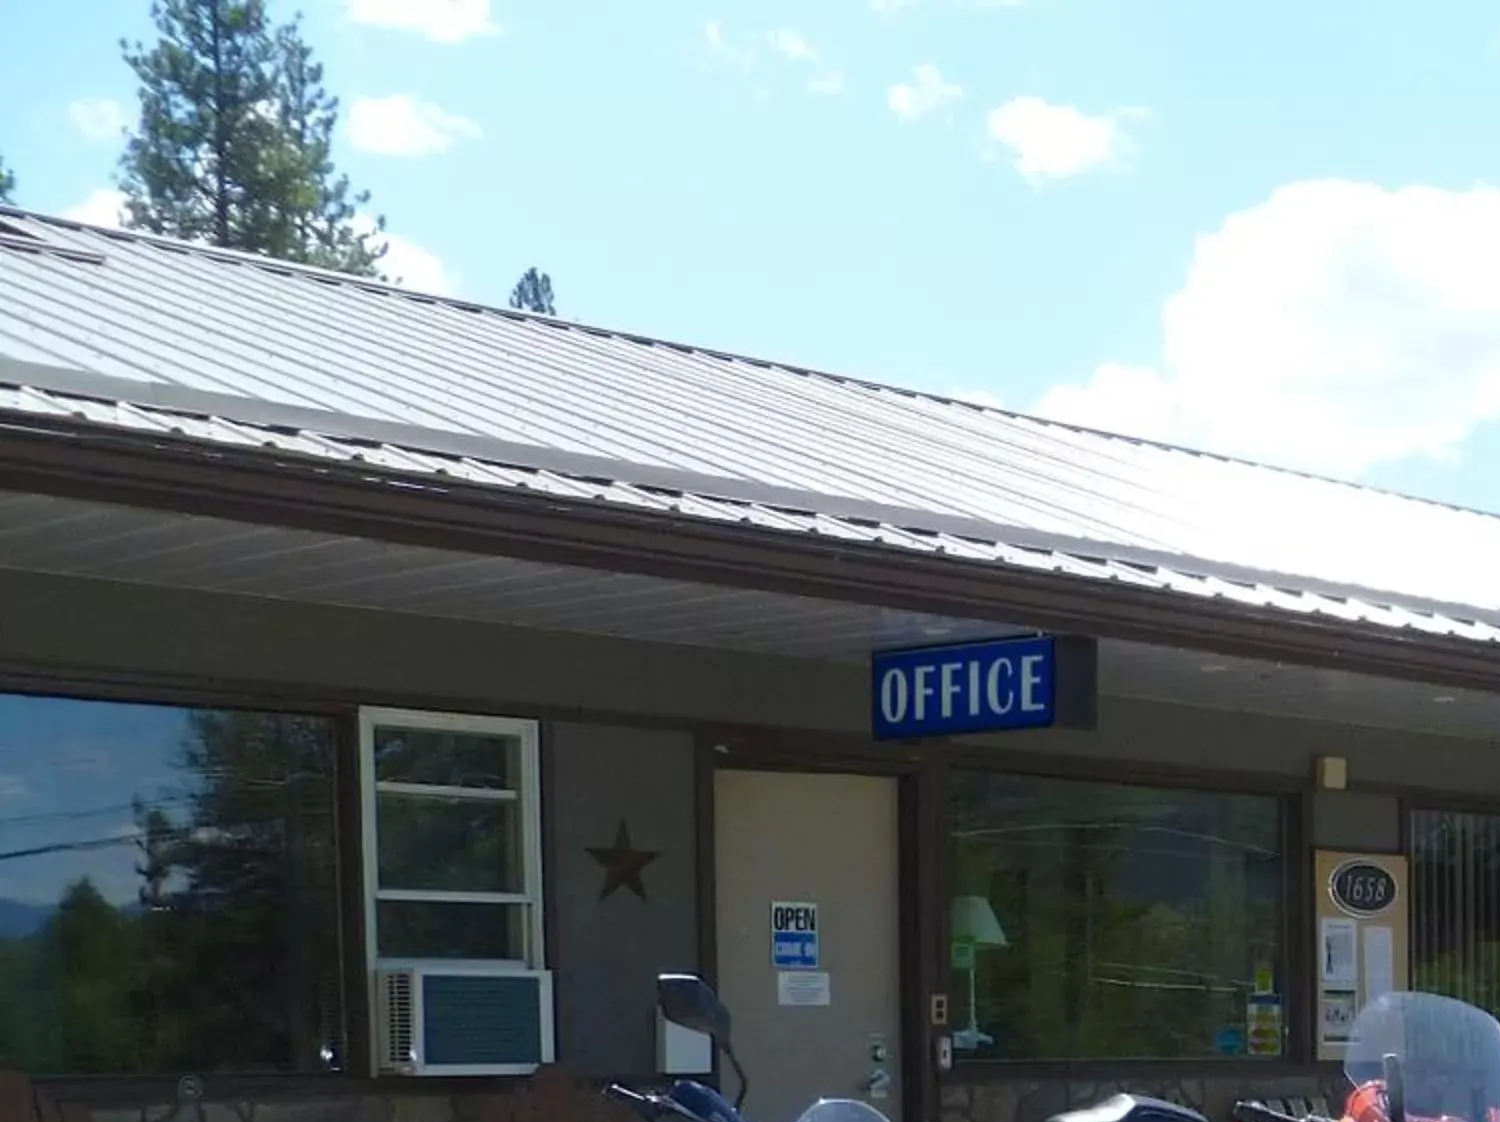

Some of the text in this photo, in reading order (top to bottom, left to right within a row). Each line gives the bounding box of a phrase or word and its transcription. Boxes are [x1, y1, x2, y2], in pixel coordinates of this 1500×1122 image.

[881, 655, 1045, 723] OFFICE
[1345, 875, 1387, 902] 1658
[774, 906, 816, 931] OPEN
